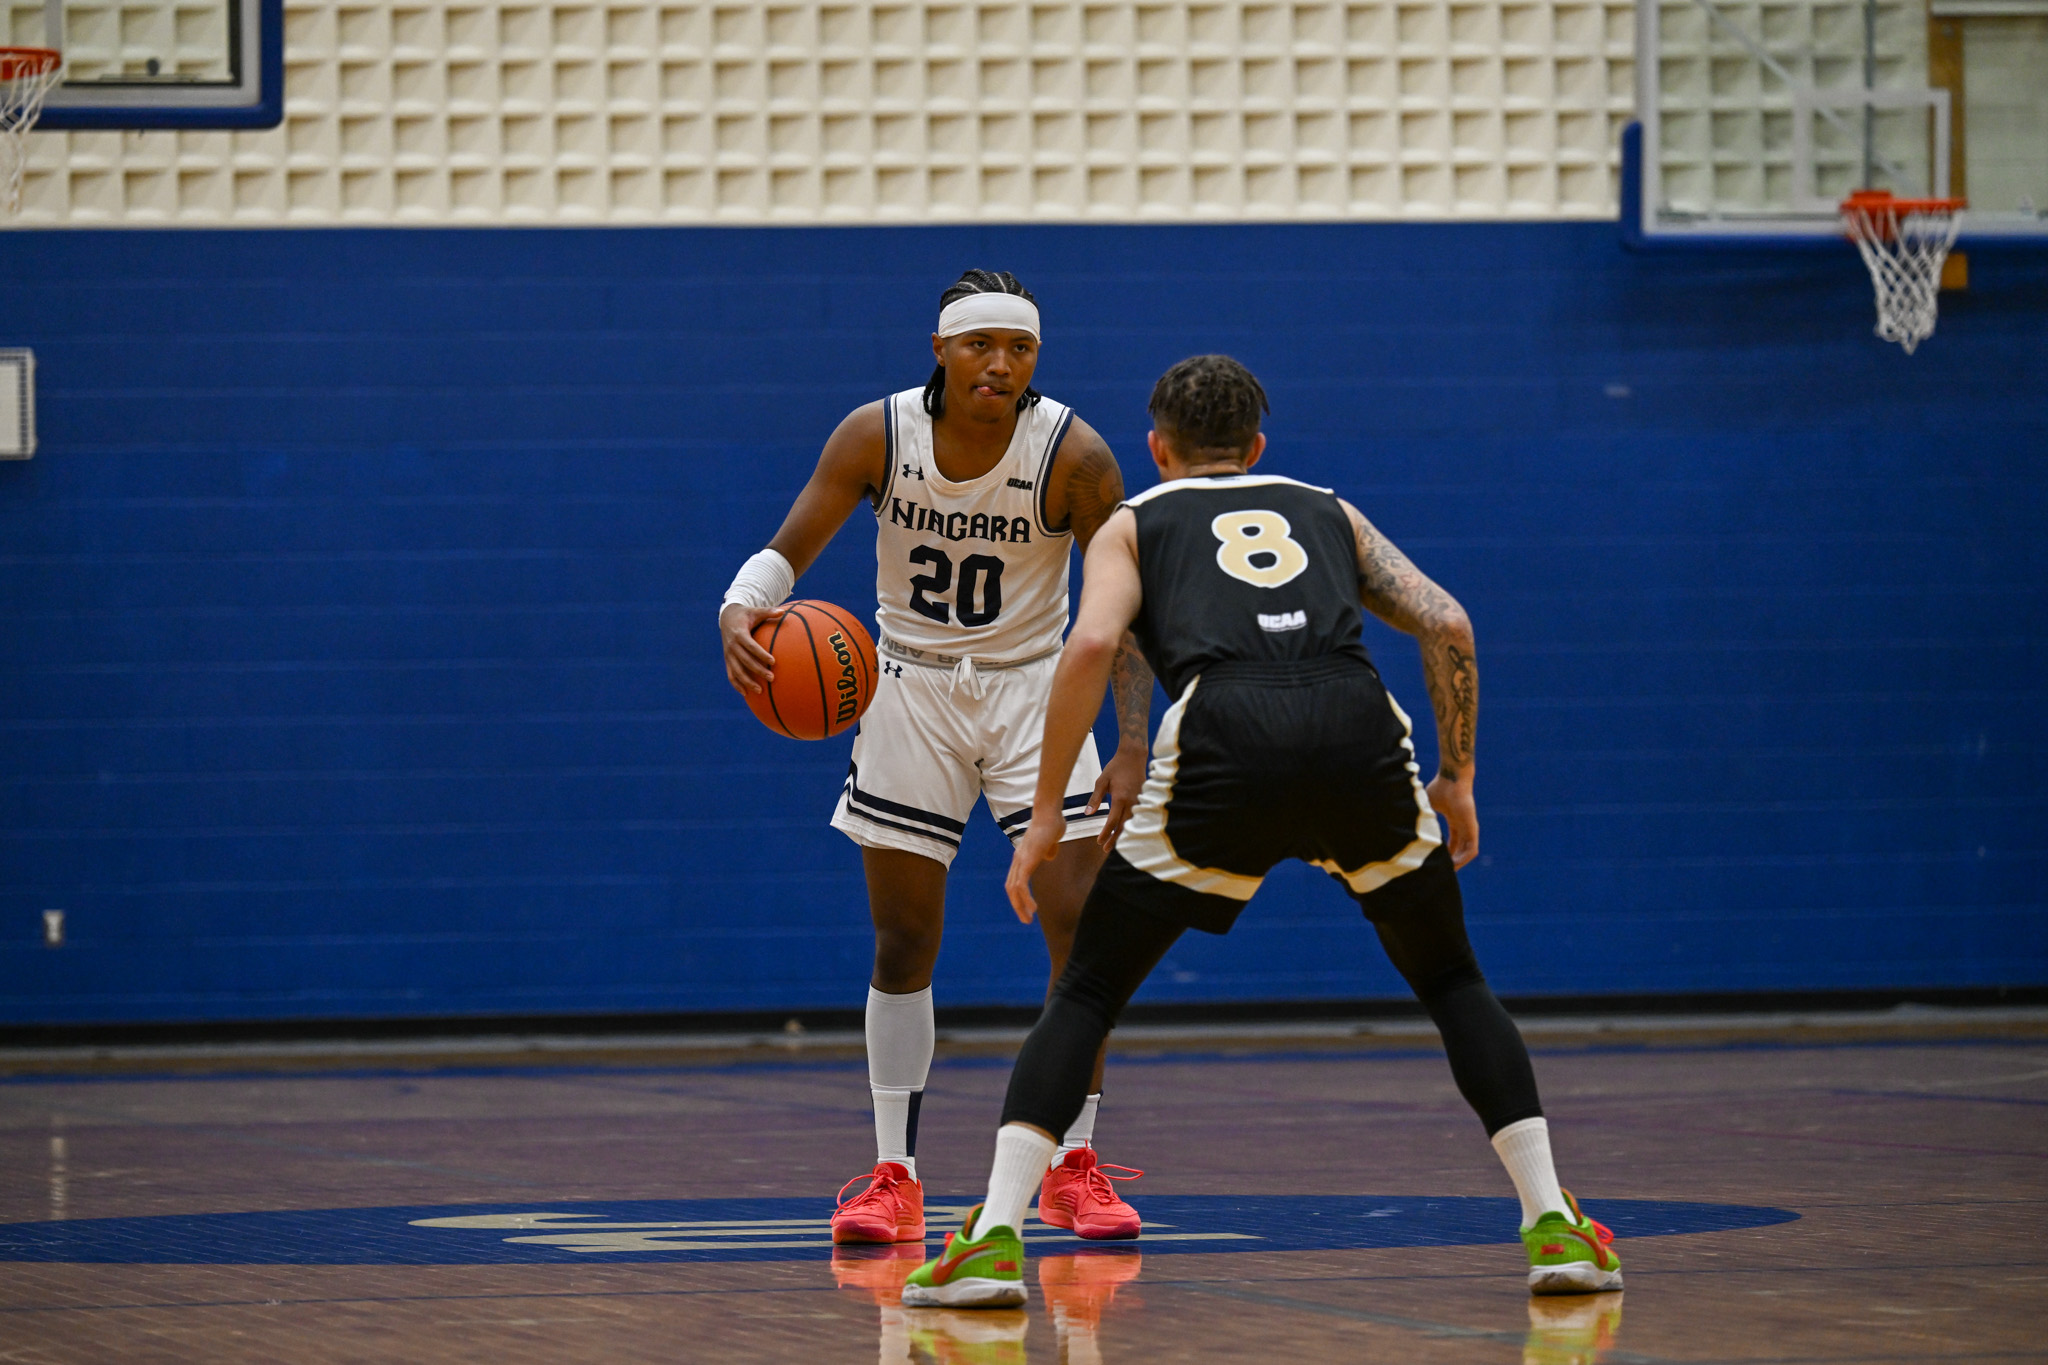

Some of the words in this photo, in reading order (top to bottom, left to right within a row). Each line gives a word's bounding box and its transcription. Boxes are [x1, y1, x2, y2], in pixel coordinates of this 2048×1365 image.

[890, 497, 1032, 543] NIAGARA
[1210, 509, 1309, 589] 8
[908, 544, 1005, 628] 20
[827, 631, 859, 726] Wilson
